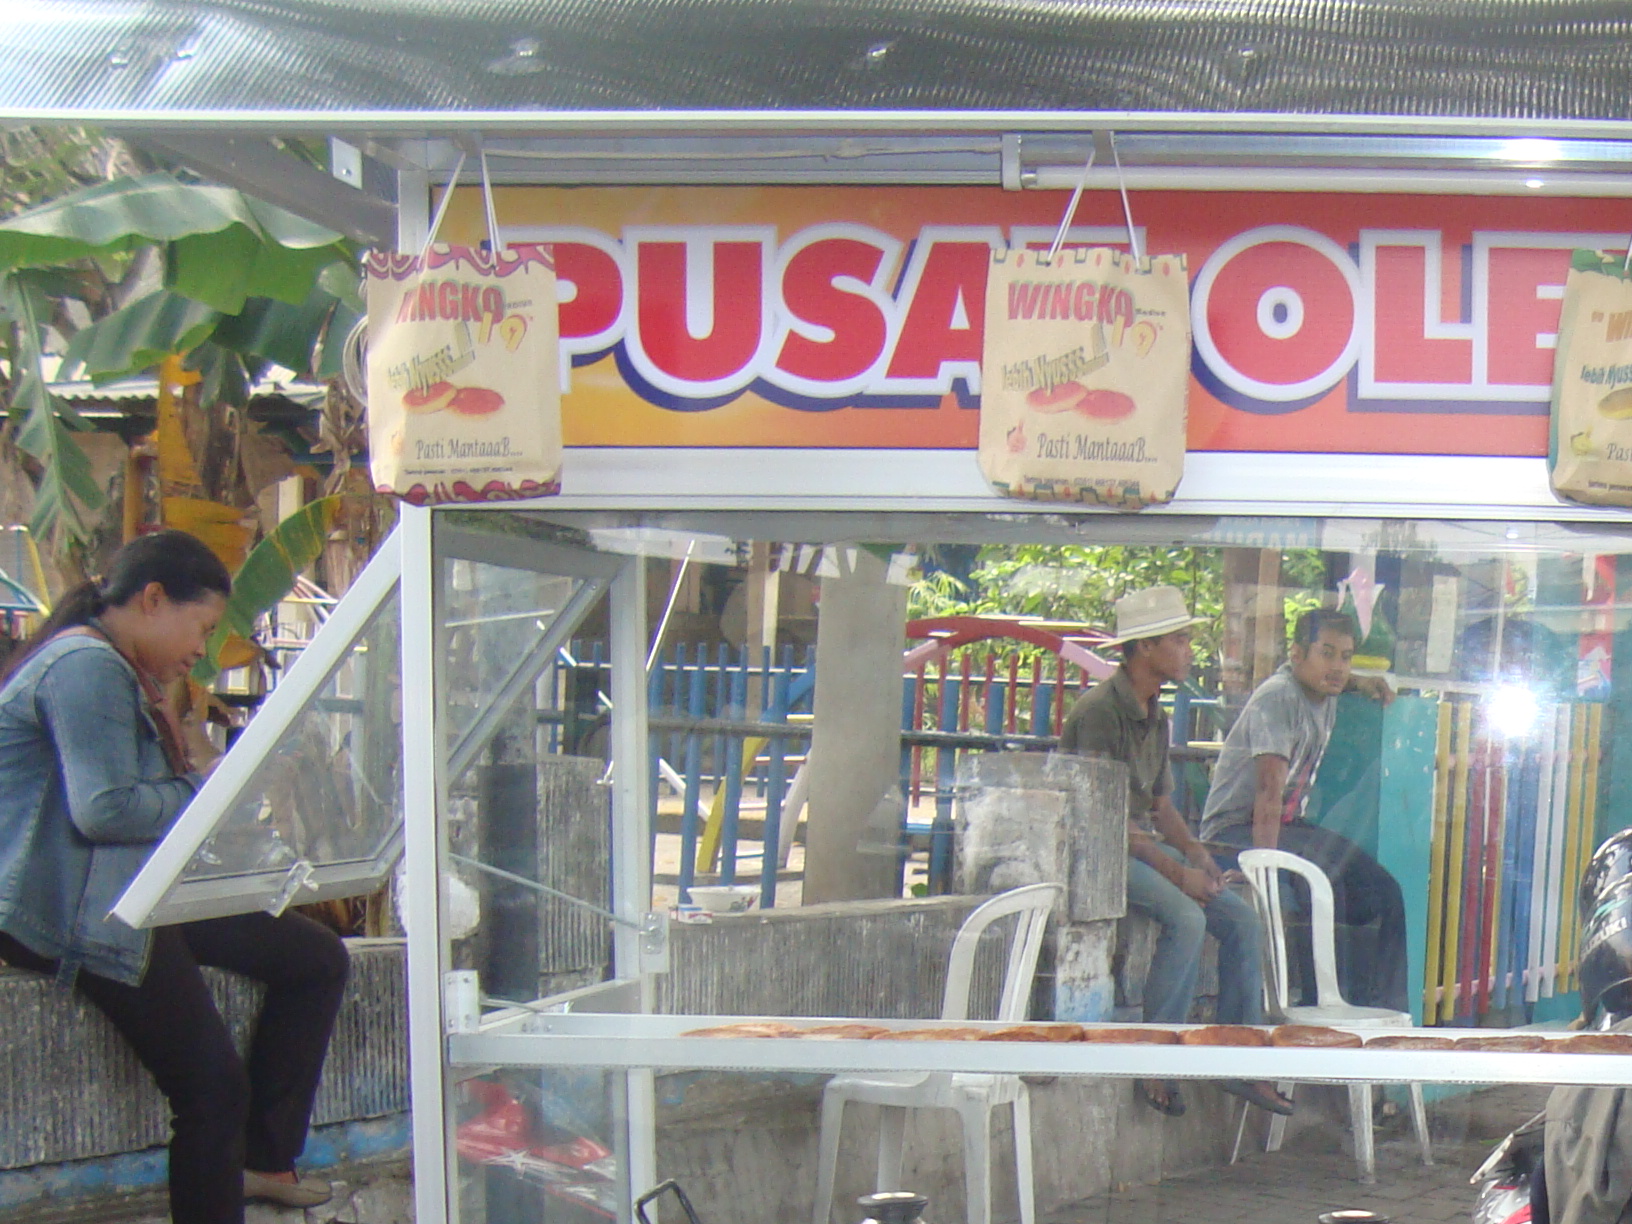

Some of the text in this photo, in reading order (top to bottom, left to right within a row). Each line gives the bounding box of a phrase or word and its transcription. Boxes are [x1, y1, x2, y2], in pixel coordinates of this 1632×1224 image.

[394, 279, 505, 325] INGKO
[500, 222, 1146, 402] PUSA
[1008, 281, 1134, 328] WINGKO
[416, 438, 444, 460] Pasti
[1037, 432, 1071, 459] Pasti
